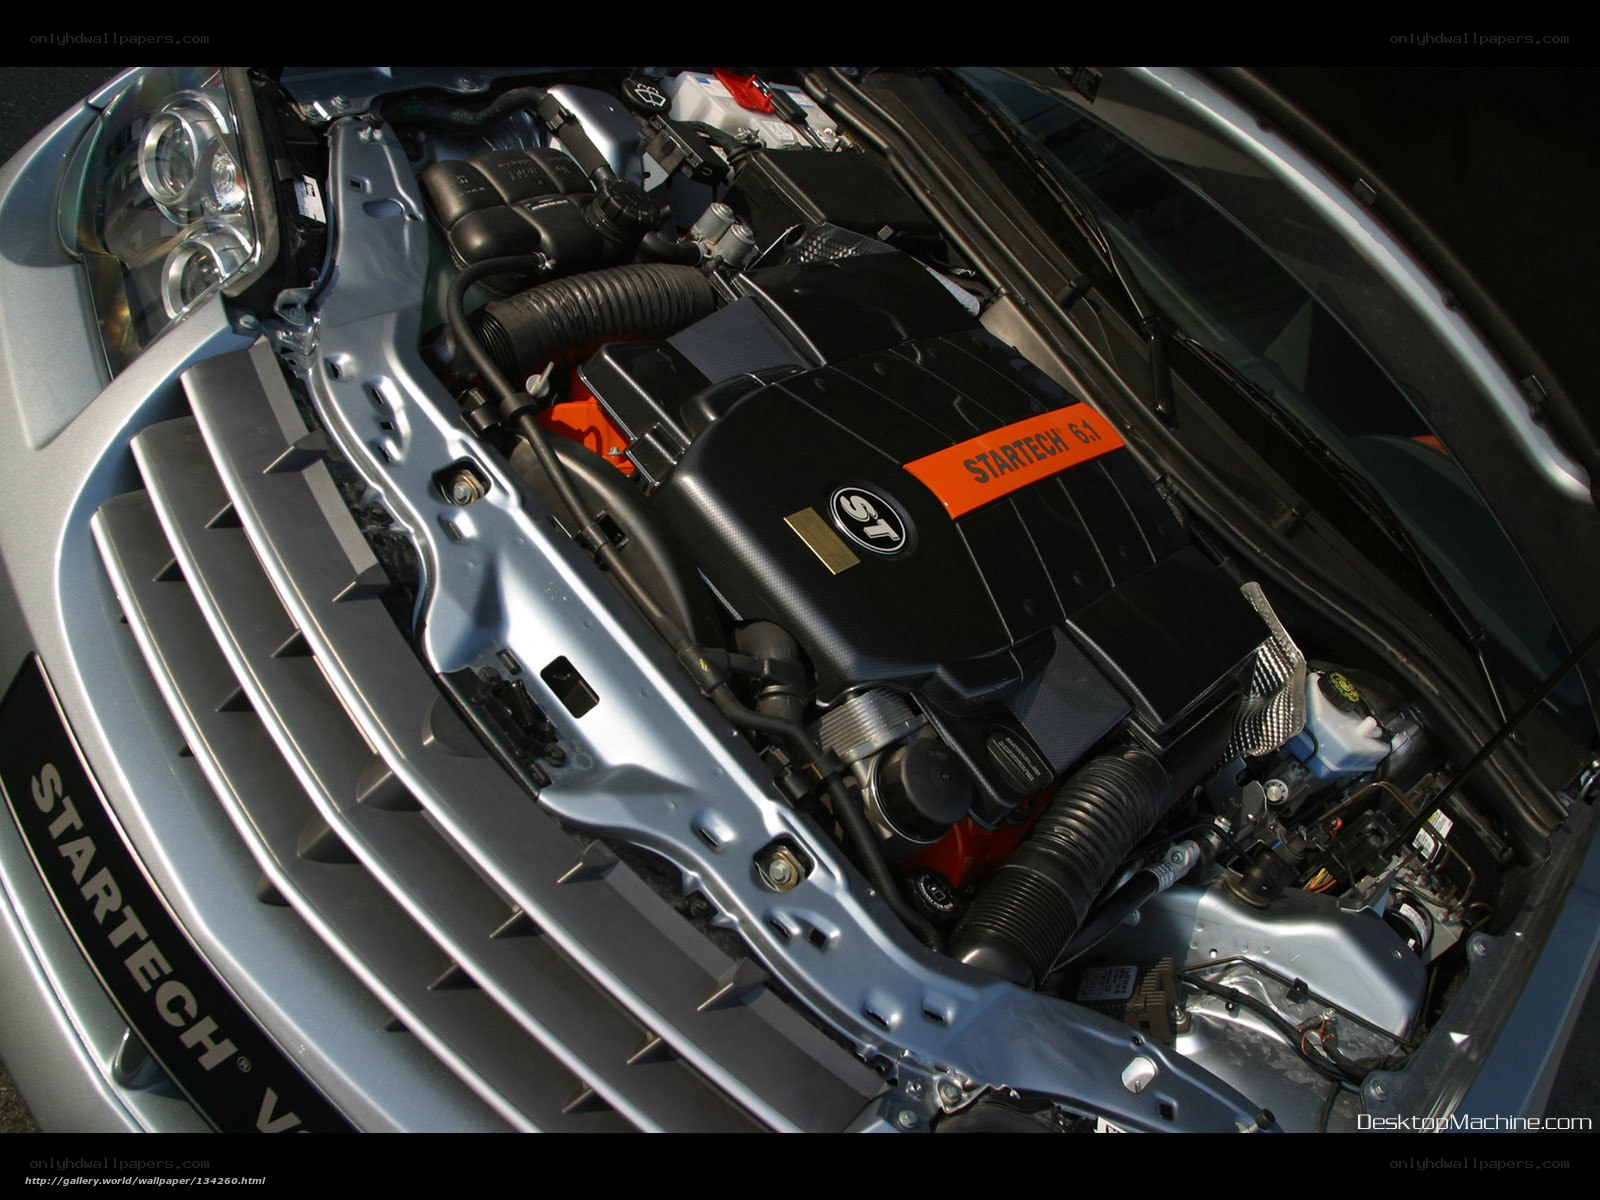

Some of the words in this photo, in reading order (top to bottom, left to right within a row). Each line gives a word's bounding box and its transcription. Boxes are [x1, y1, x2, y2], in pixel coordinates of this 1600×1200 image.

[963, 427, 1069, 484] STARTECH
[1068, 419, 1102, 444] 6.1
[840, 495, 901, 541] ST
[256, 1086, 312, 1133] V
